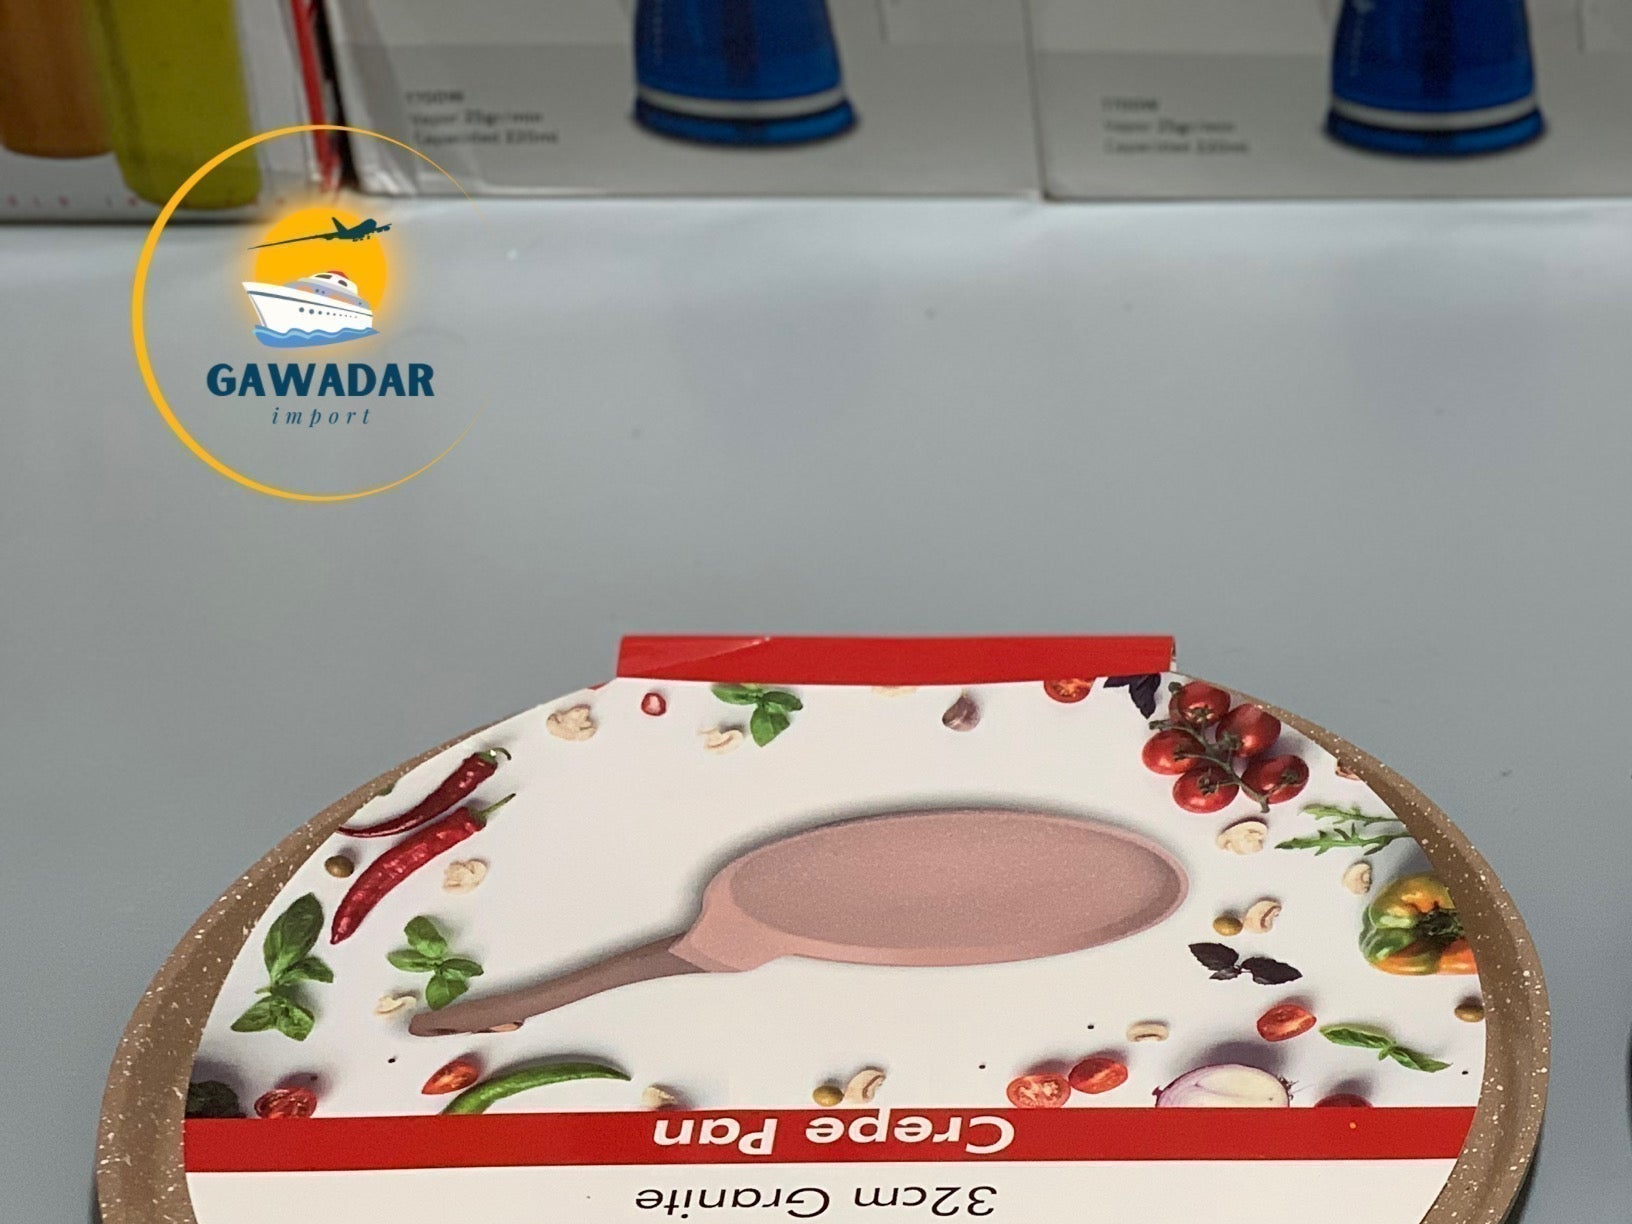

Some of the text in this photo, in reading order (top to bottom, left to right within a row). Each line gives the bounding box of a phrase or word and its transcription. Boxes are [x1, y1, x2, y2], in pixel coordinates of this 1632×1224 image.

[652, 1106, 1015, 1155] Crepe Pan
[634, 1185, 998, 1219] 32cm Granite
